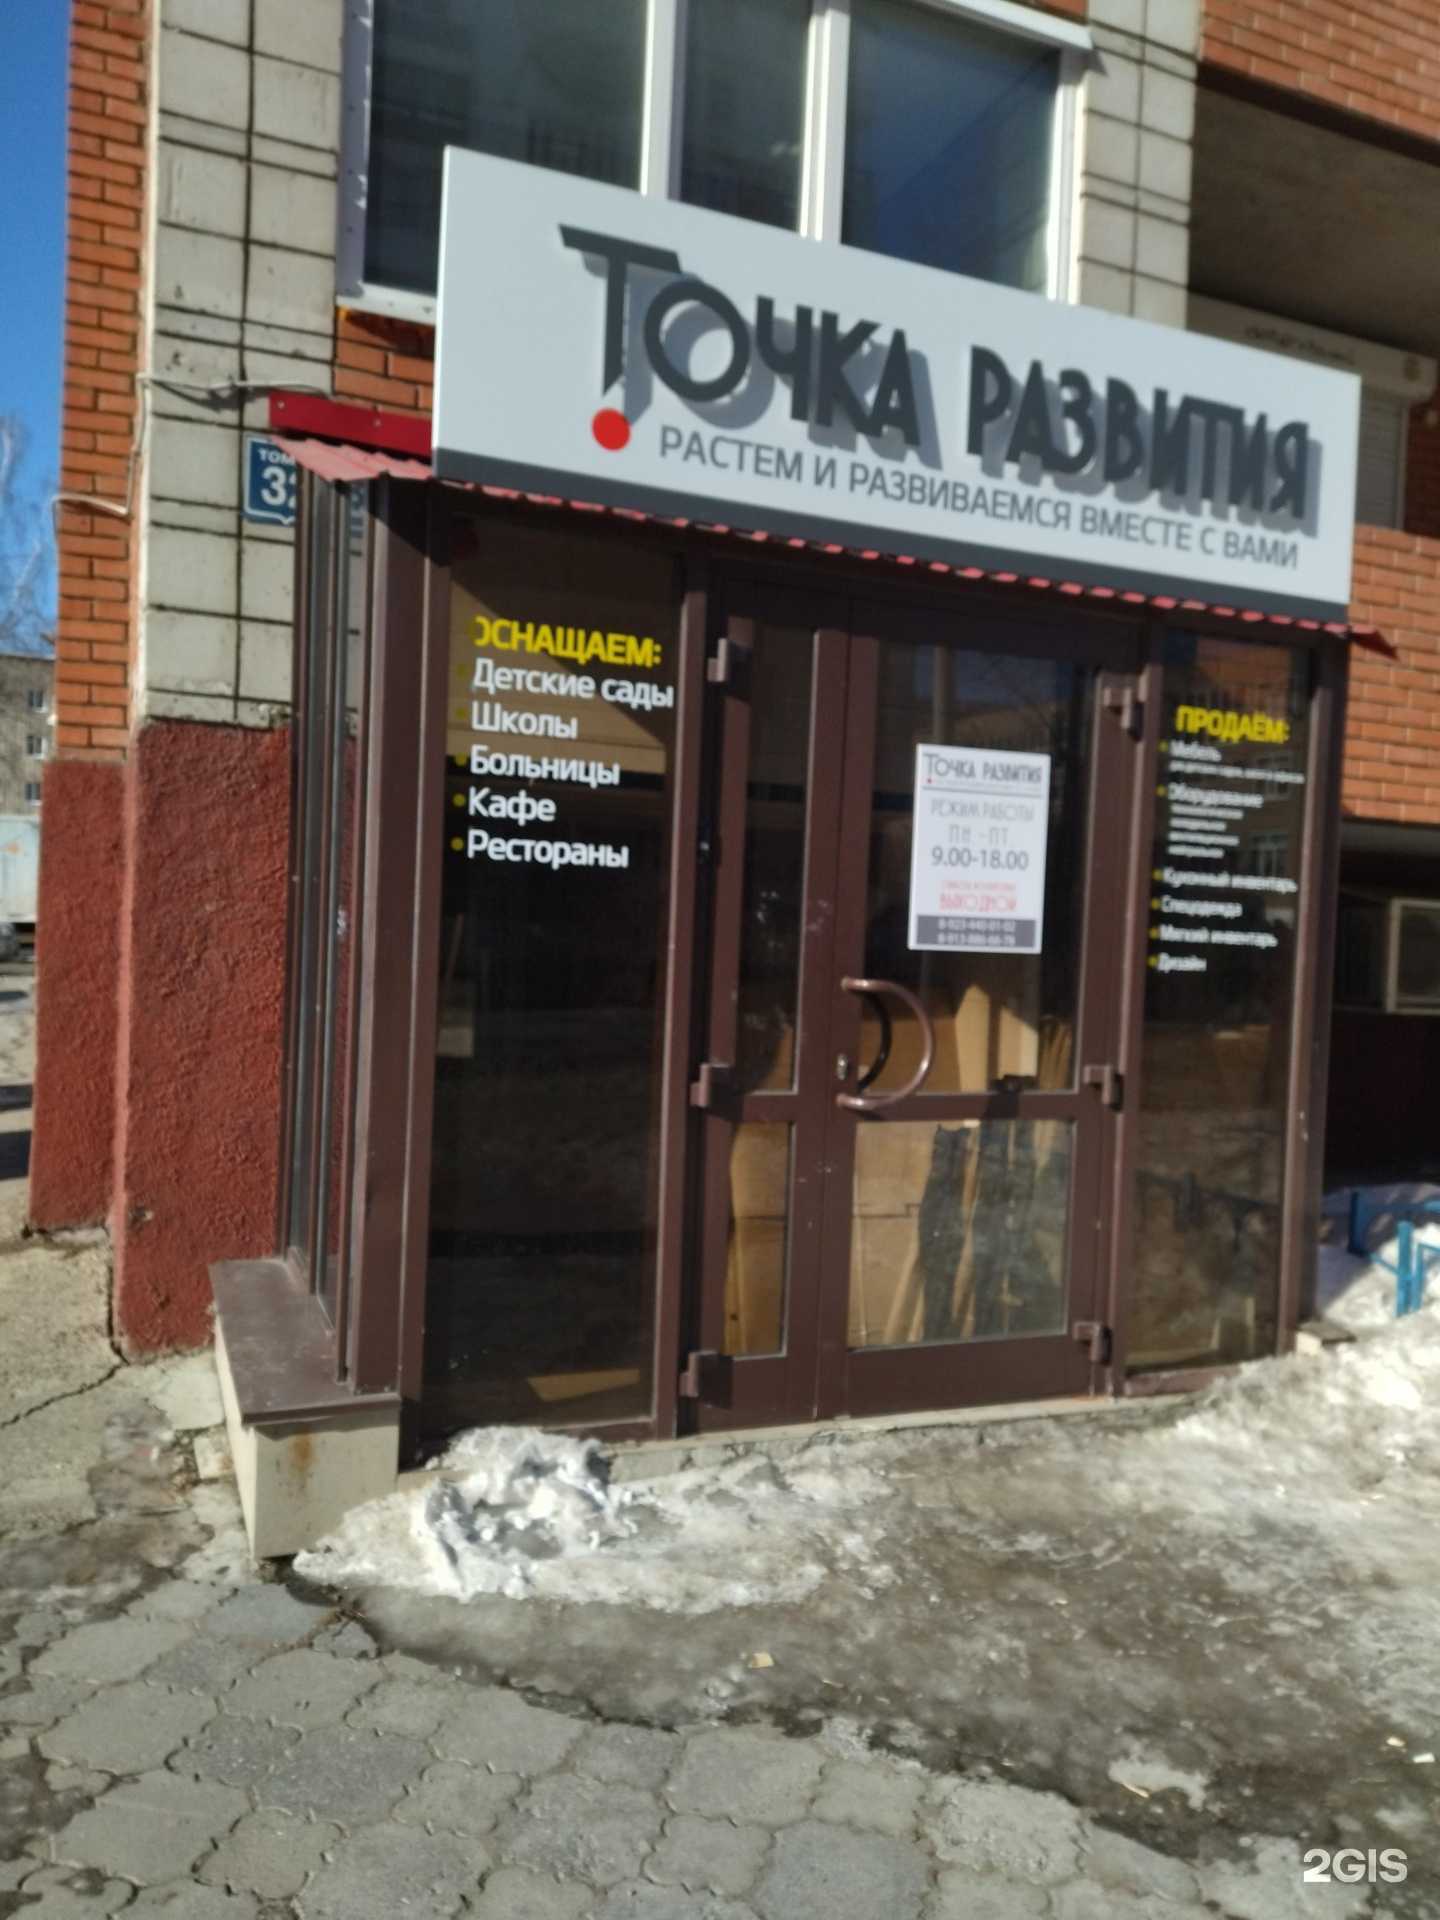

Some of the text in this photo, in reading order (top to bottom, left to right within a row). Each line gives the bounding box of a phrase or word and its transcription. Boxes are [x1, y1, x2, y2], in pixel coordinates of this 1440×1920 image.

[559, 224, 1310, 518] ТОЧКА РАЗВИТИЯ
[660, 425, 1298, 570] РАСТЕМ И РАЗВИВАЕМСЯ ВМЕСТЕ С ВАМИ
[472, 656, 675, 711] Детские сады
[471, 700, 578, 739] Школы
[470, 744, 620, 789] Больницы
[922, 753, 977, 781] ТОЧКА
[468, 786, 557, 827] Кафе
[467, 828, 630, 870] Рестораны
[930, 845, 1030, 871] 9.00-18.00
